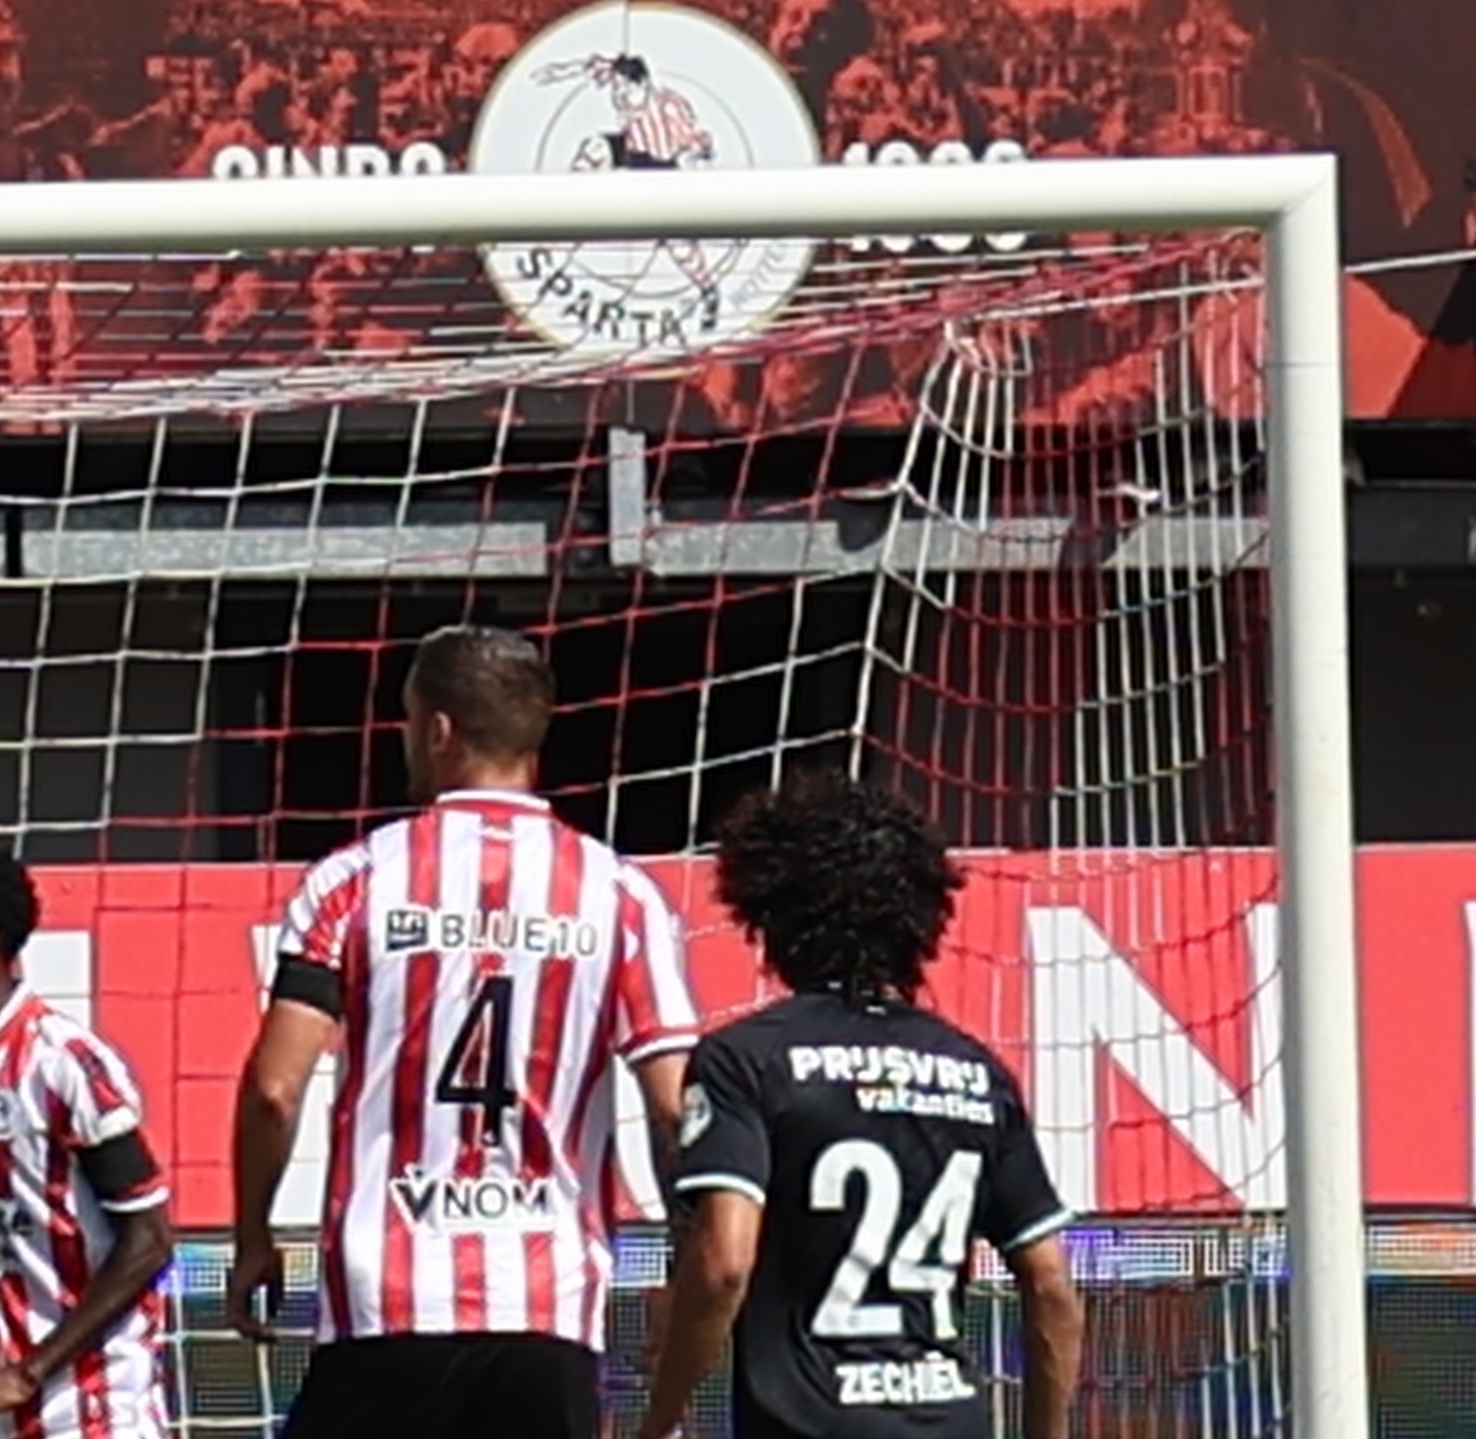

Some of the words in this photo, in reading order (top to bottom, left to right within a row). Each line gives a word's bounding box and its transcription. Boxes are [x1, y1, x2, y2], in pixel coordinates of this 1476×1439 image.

[518, 250, 689, 348] SPARTA
[441, 914, 599, 956] BLUE10
[435, 976, 519, 1147] 4
[857, 1086, 994, 1125] vakanties
[809, 1138, 983, 1340] 24
